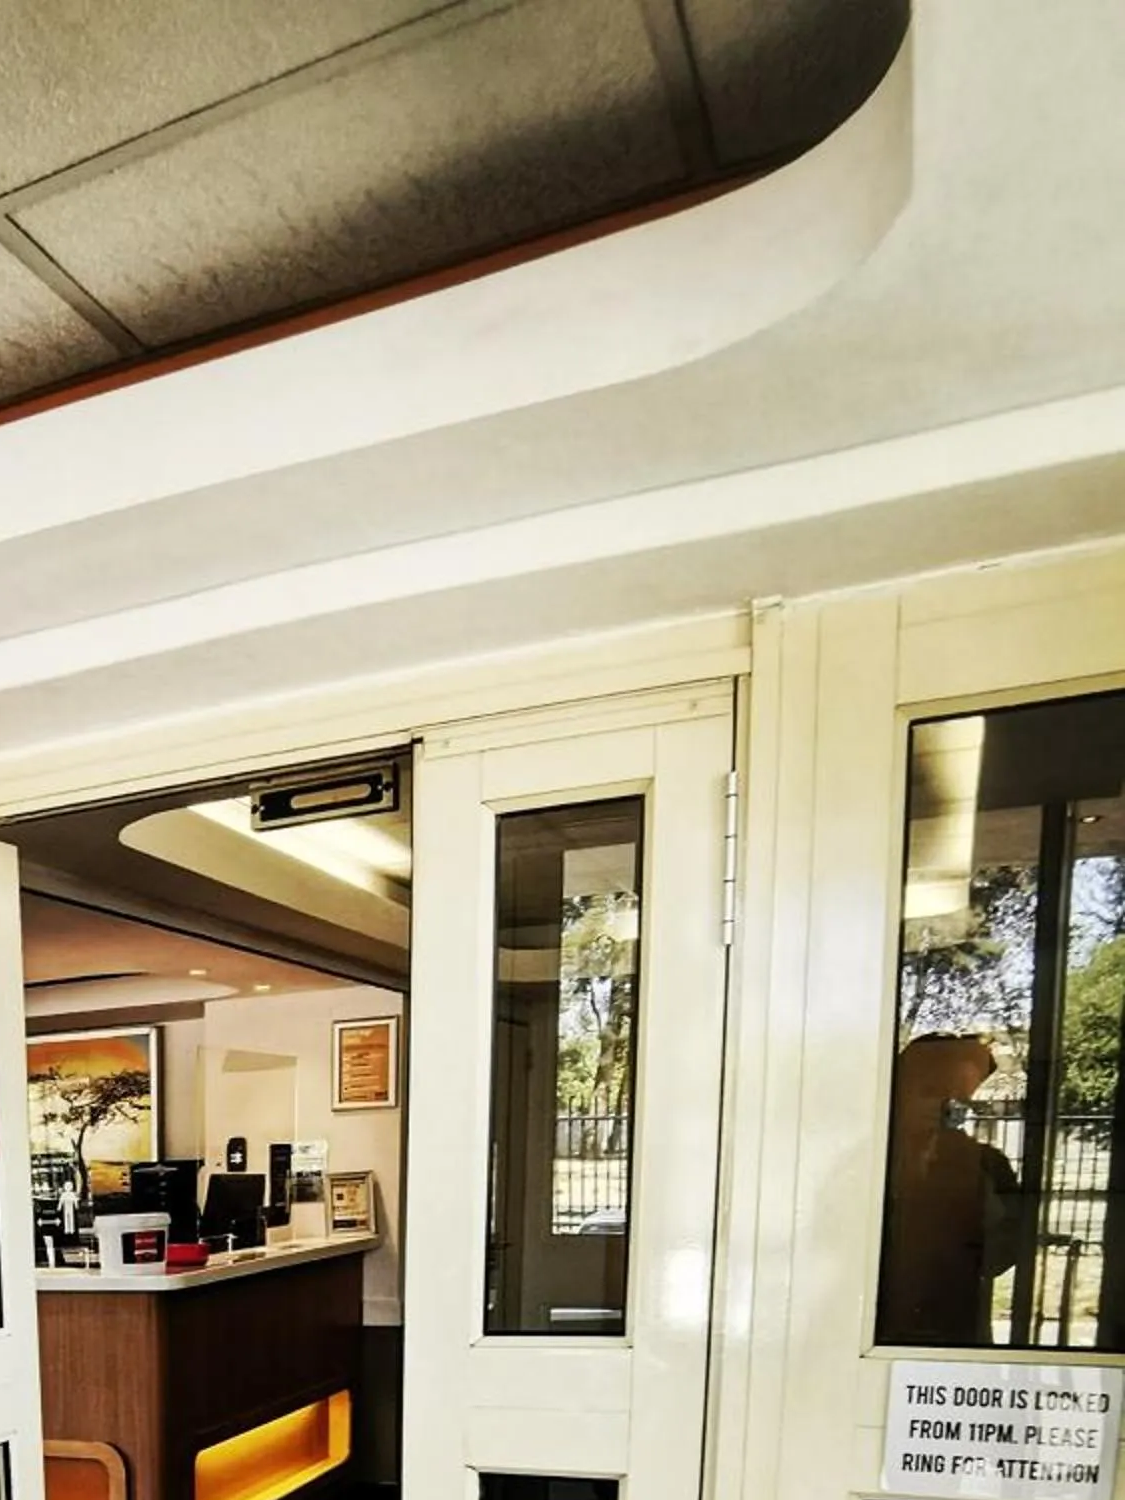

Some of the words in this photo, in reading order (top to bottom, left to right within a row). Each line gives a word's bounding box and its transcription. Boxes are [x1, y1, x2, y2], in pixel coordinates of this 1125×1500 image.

[906, 1385, 947, 1406] THIS
[953, 1387, 1003, 1409] DOOR
[1009, 1389, 1029, 1410] IS
[1034, 1390, 1111, 1413] LOCKED
[909, 1419, 961, 1441] FROM
[968, 1422, 1018, 1445] 11PM.
[1024, 1425, 1099, 1449] PLEASE
[902, 1453, 945, 1474] RING
[951, 1456, 987, 1477] FOR
[996, 1458, 1100, 1484] ATTENTION
